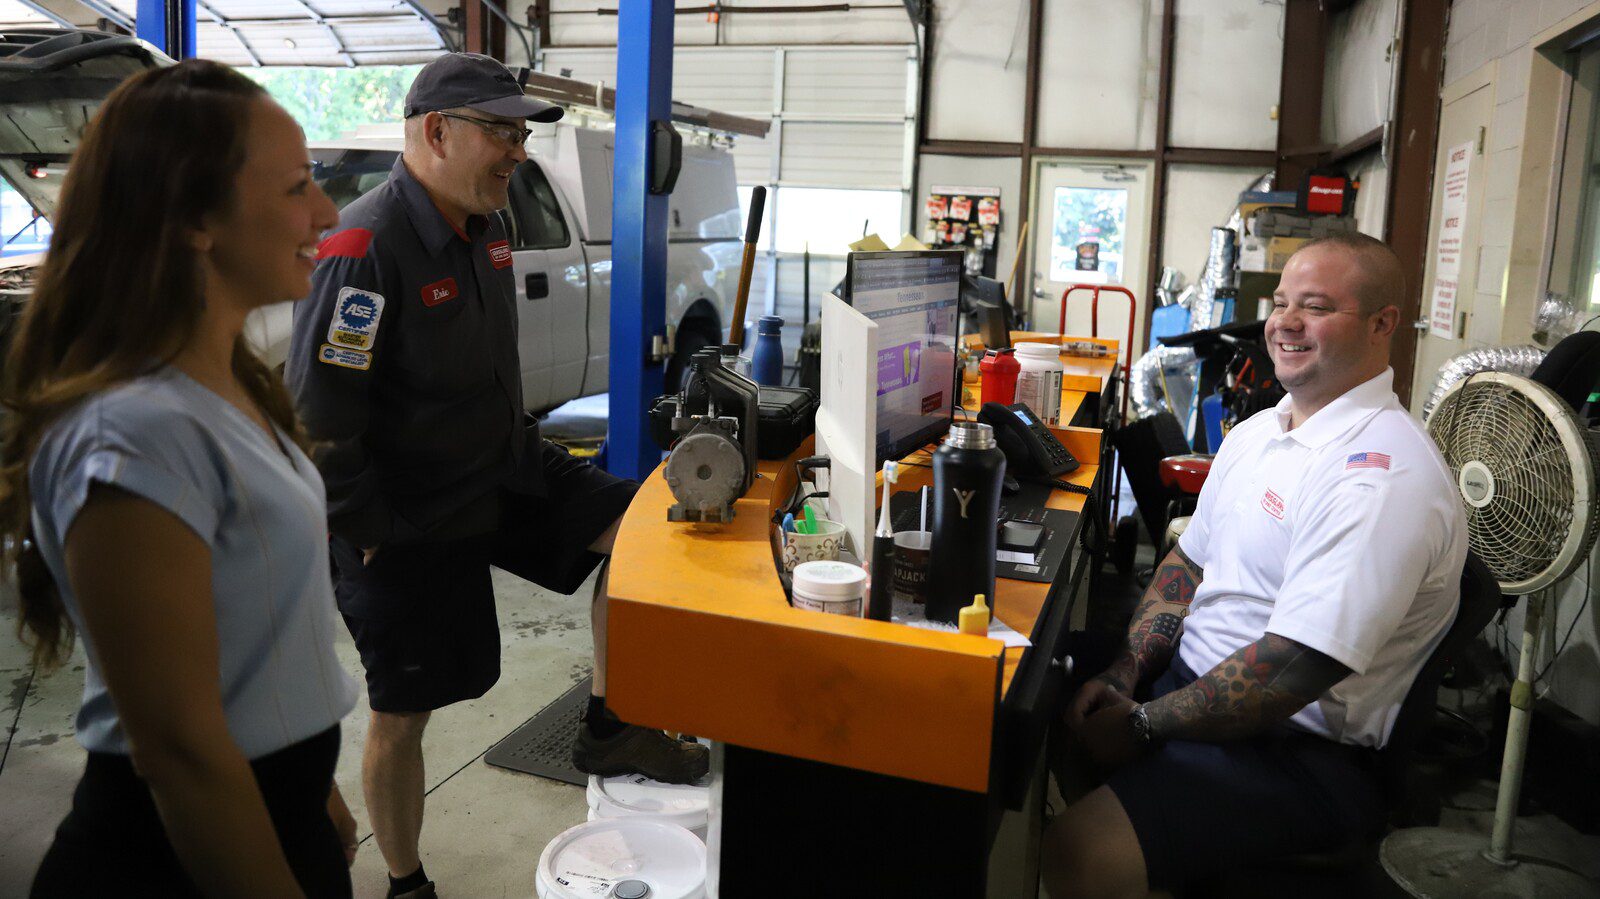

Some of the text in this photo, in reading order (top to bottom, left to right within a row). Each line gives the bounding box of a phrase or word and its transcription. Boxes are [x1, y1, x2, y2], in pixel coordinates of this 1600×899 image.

[432, 288, 450, 301] Eric
[345, 303, 373, 319] ASE
[338, 325, 370, 336] CERTIFIED
